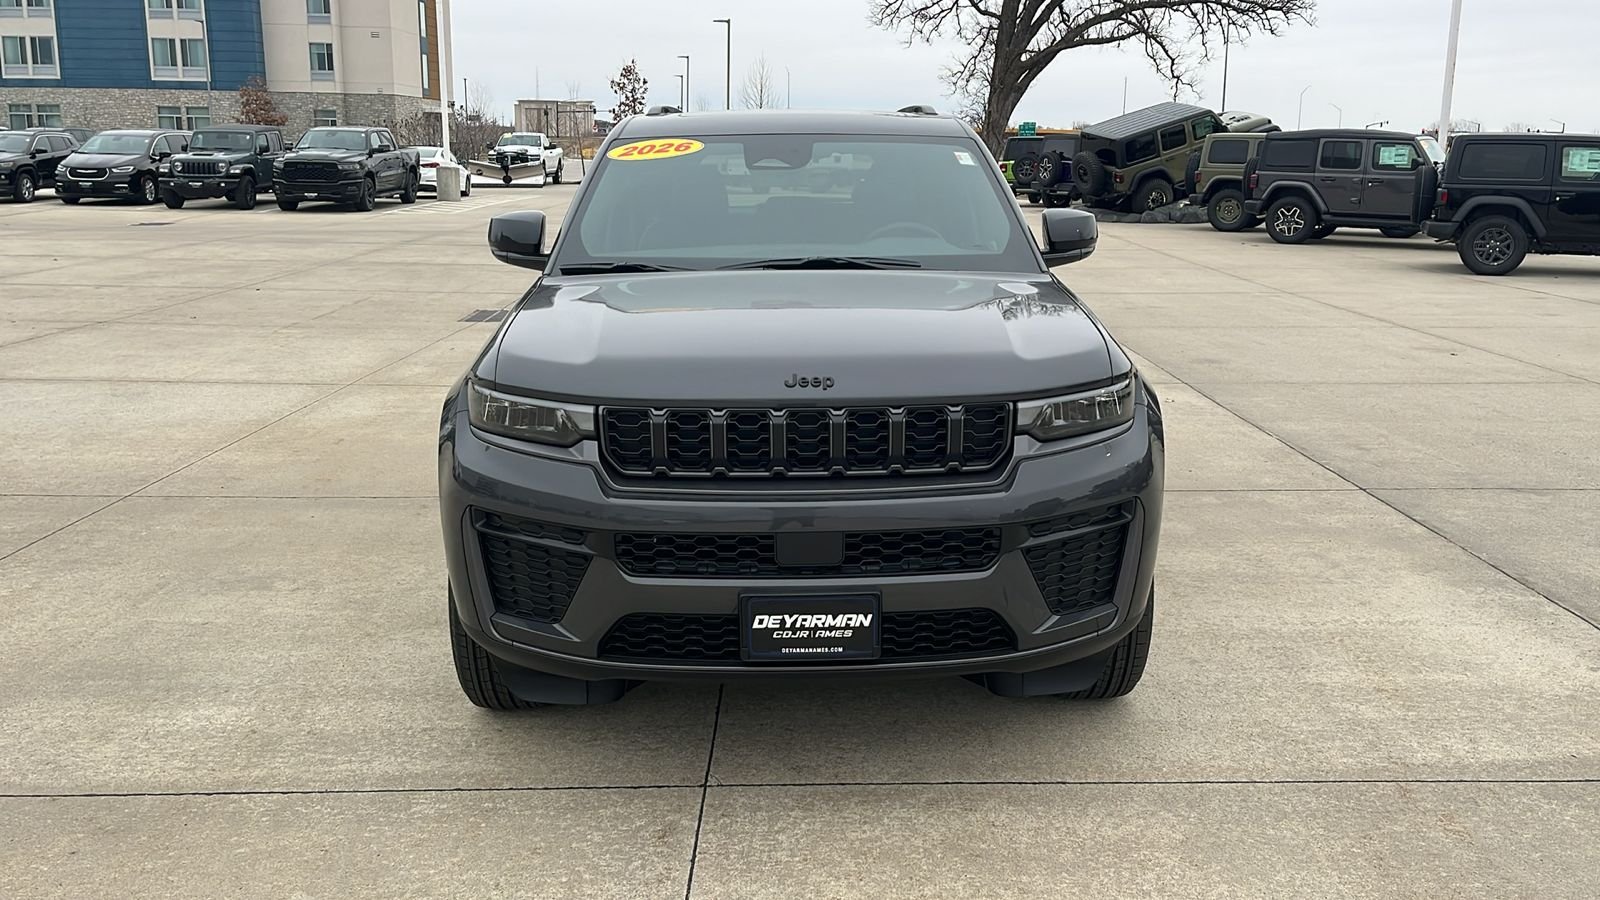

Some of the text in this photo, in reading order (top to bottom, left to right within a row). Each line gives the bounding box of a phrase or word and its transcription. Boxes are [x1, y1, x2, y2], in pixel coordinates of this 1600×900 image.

[617, 143, 693, 157] 2026
[784, 373, 834, 390] Jeep
[752, 614, 872, 629] DEYARMAN
[815, 630, 853, 638] AMES
